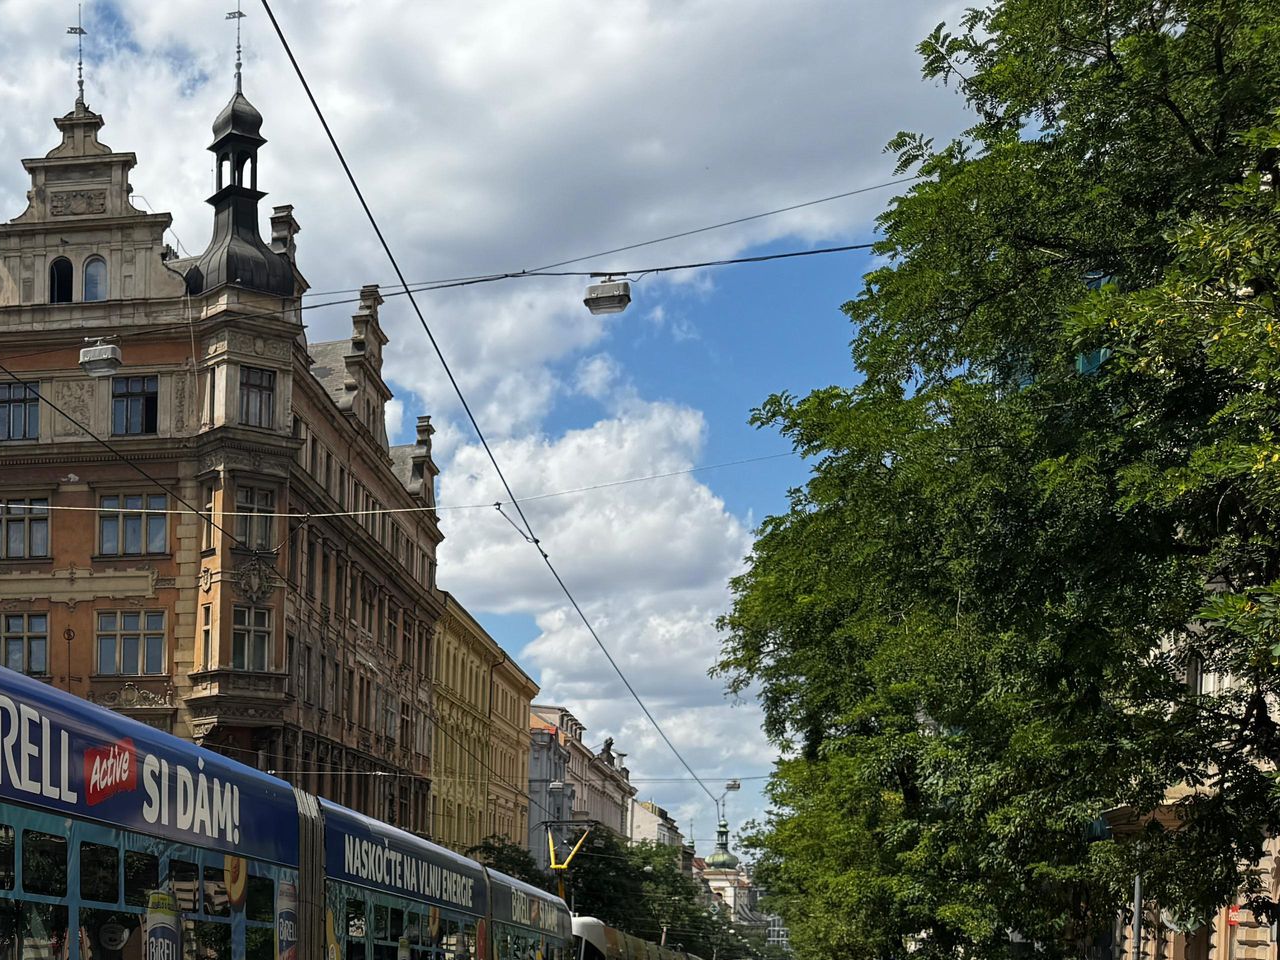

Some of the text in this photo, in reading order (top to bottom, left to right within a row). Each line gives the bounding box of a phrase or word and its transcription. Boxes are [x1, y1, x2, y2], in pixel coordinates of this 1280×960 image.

[89, 744, 131, 794] Active
[142, 753, 169, 825] SI
[344, 833, 475, 908] NASKOČTE NA VLNU ENERGIE
